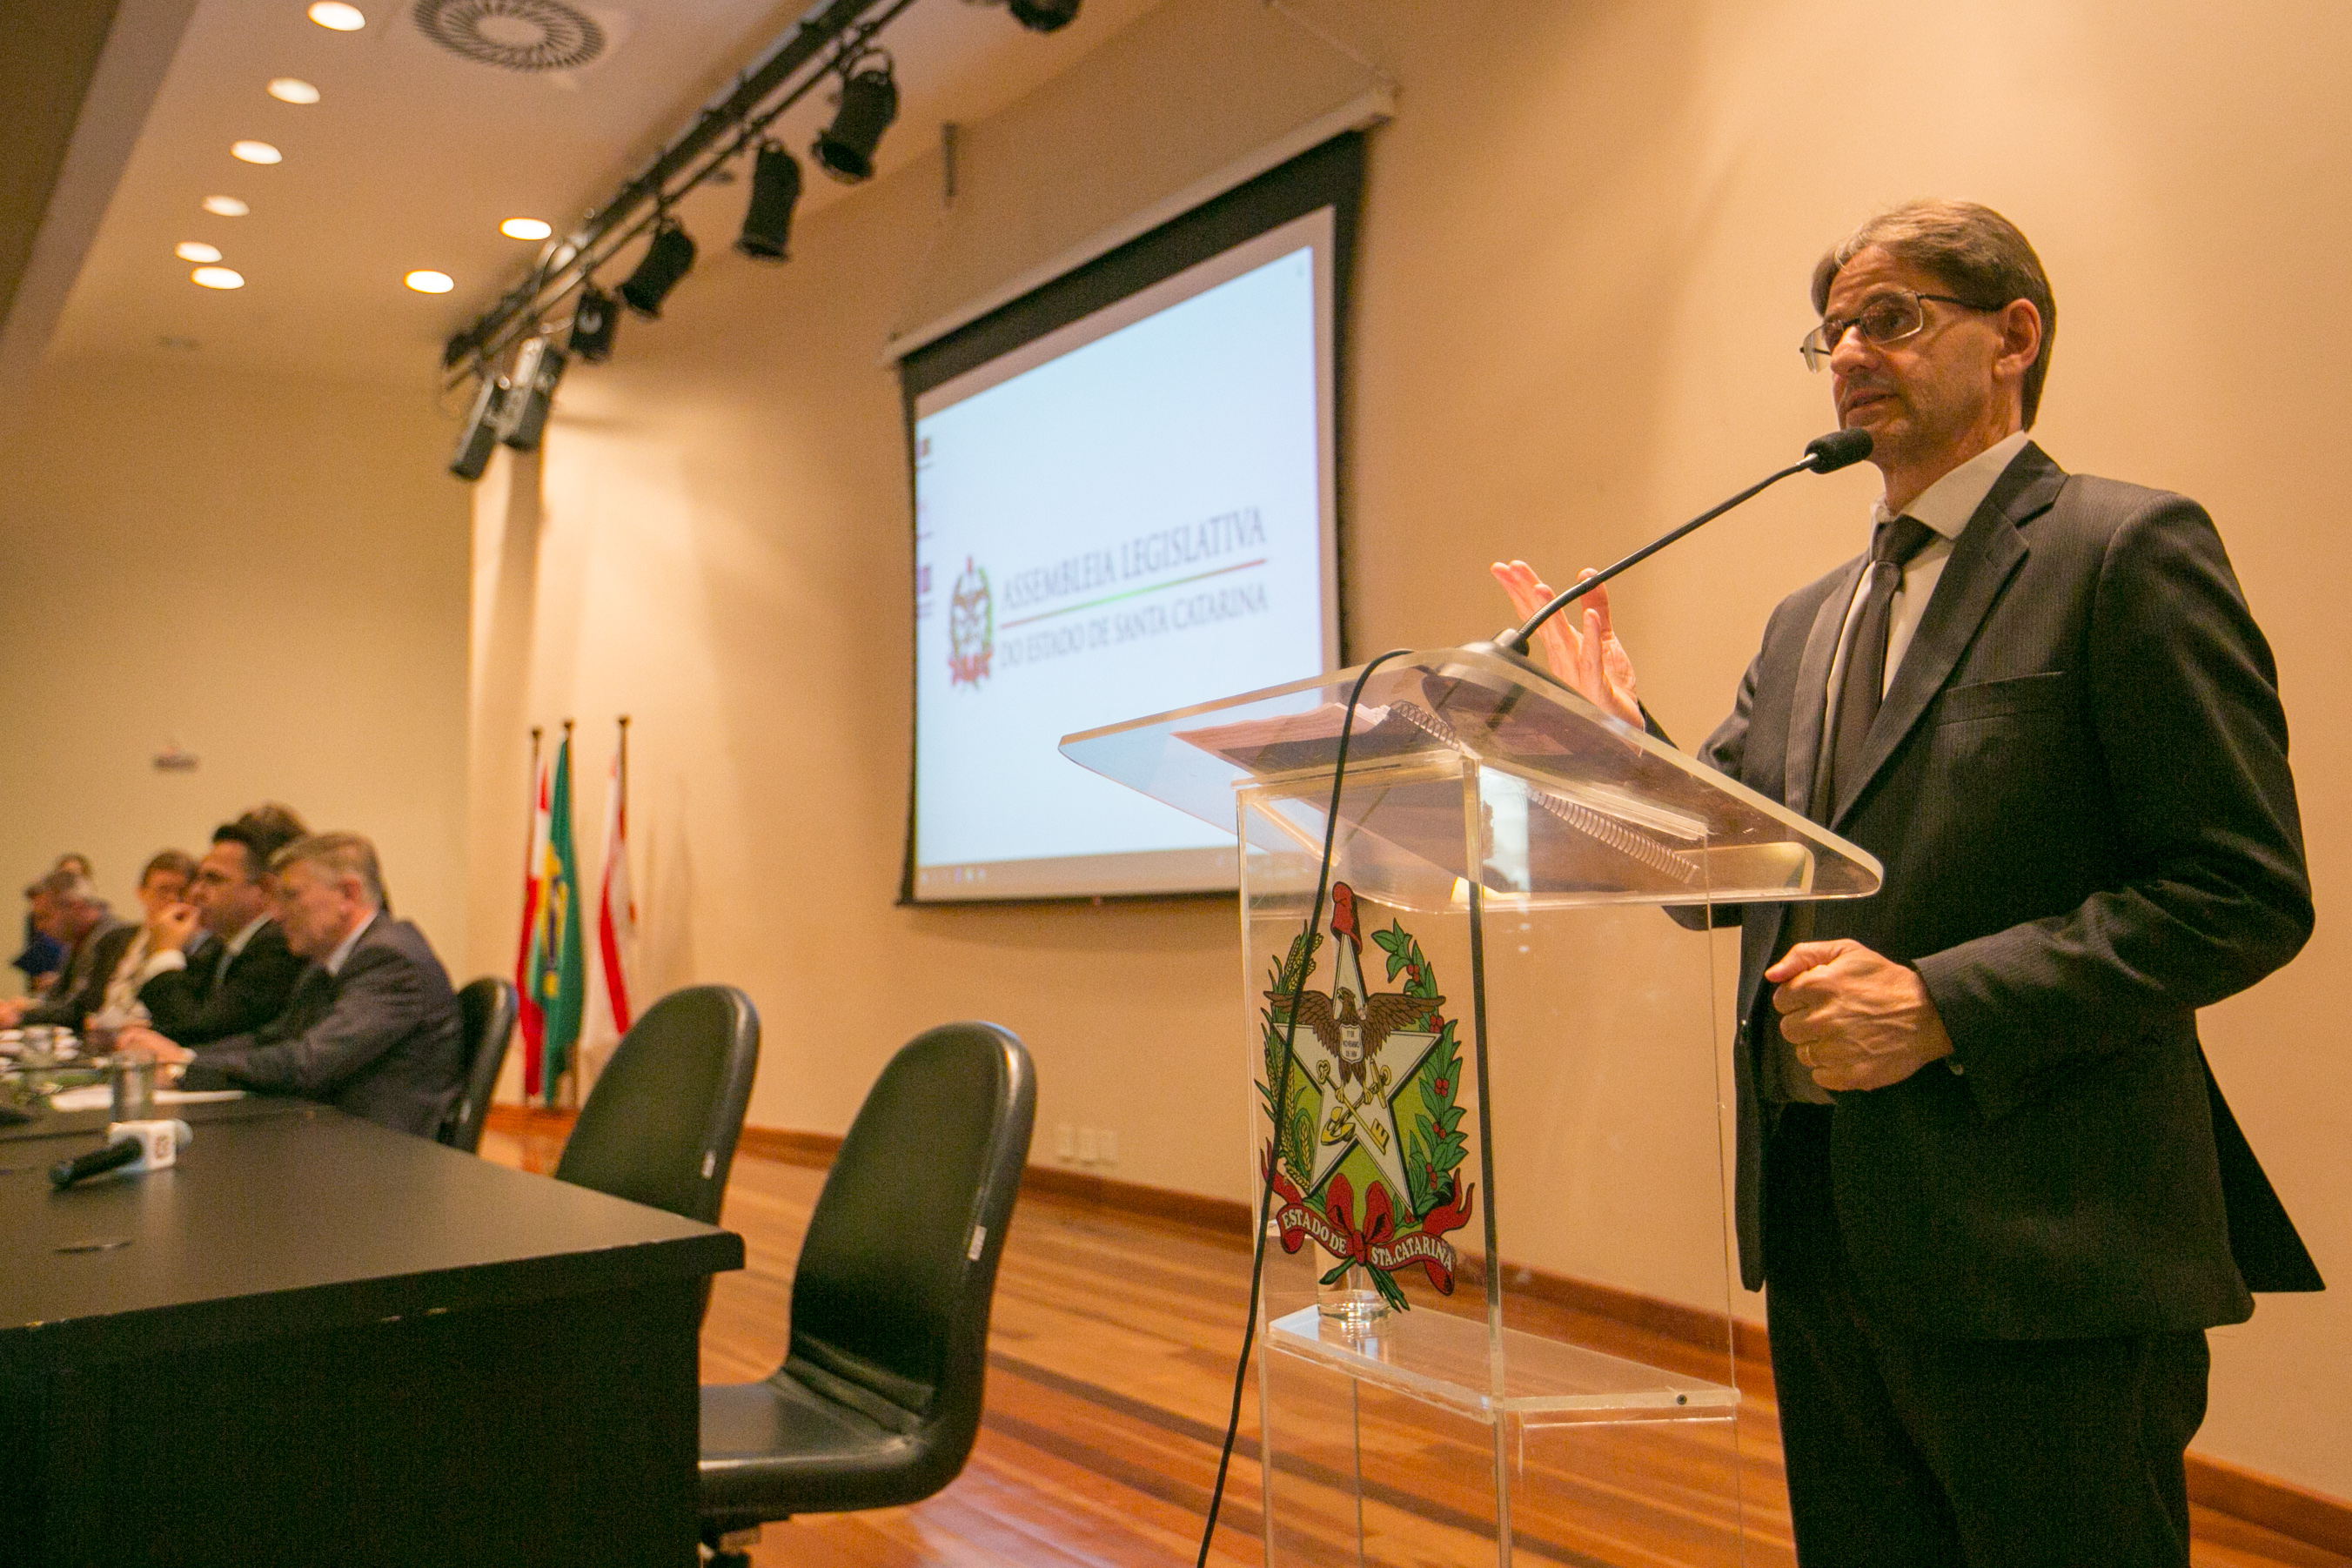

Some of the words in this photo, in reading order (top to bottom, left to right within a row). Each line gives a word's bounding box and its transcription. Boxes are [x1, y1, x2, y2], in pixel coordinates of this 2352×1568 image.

[1002, 550, 1115, 610] ASSEMBLEIA
[1121, 506, 1267, 579] LEGISLATIVA
[1000, 639, 1024, 669] DO
[1028, 623, 1085, 662] ESTADO
[1089, 617, 1109, 649] DE
[1115, 605, 1168, 646] SANTA
[1171, 582, 1269, 630] CATARINA
[1282, 1209, 1329, 1242] ESTADO
[1329, 1236, 1347, 1255] DE
